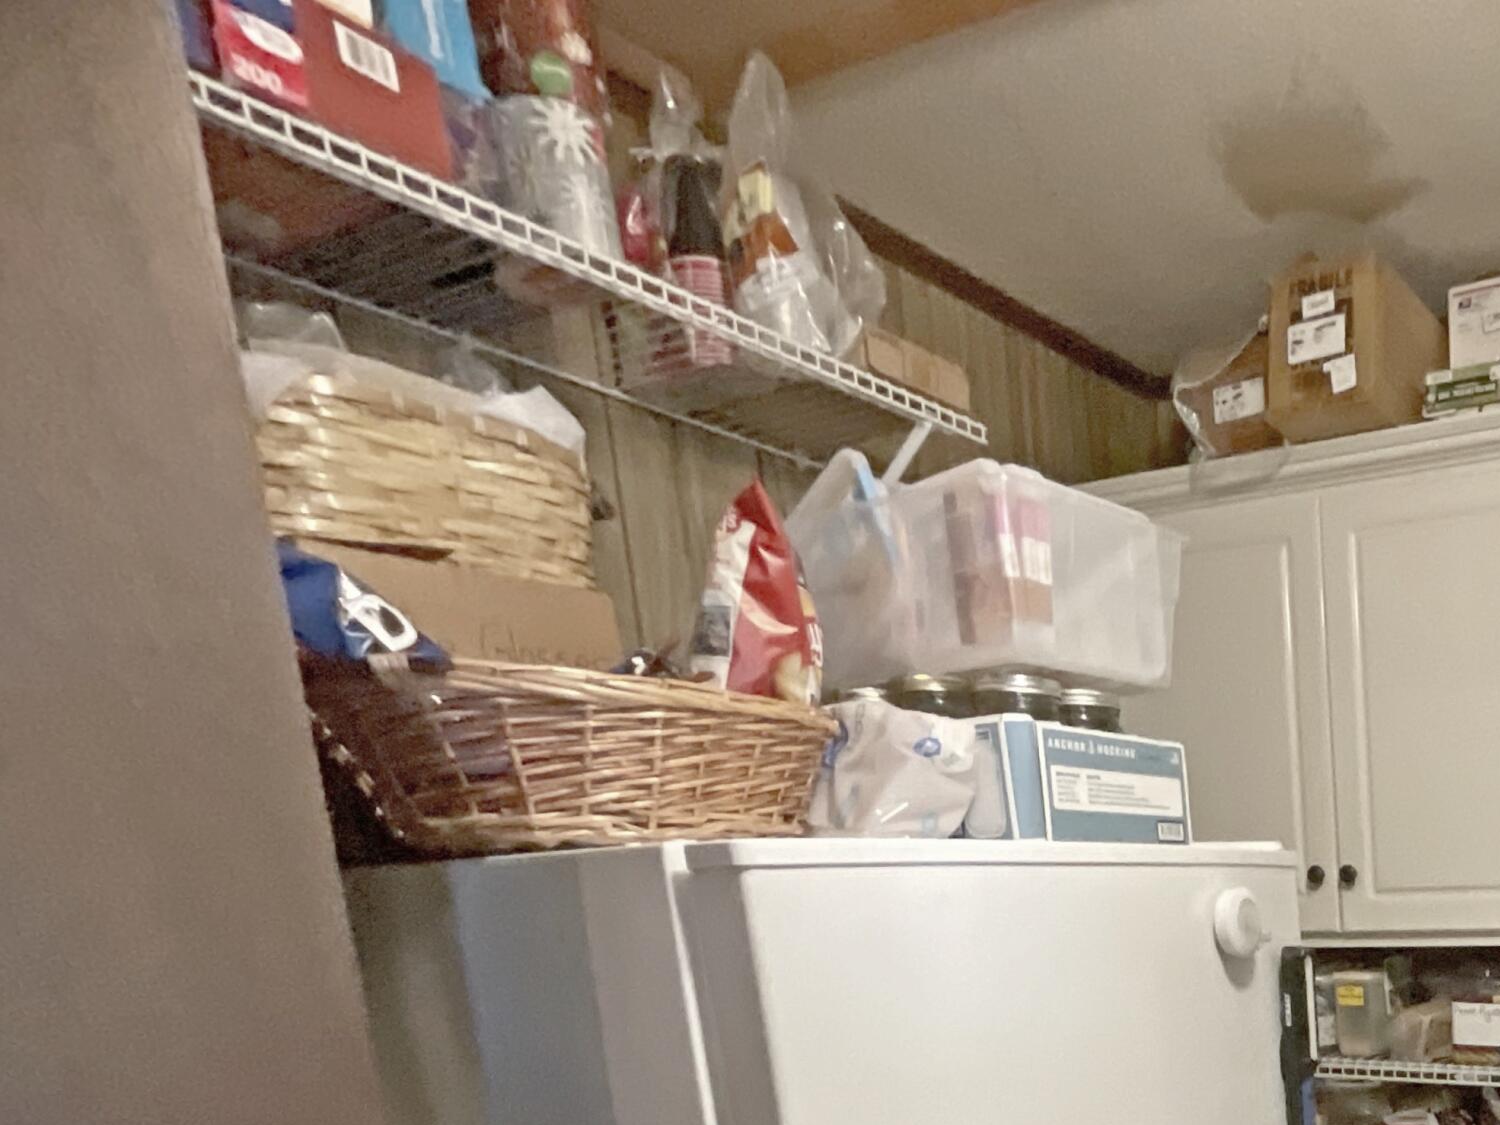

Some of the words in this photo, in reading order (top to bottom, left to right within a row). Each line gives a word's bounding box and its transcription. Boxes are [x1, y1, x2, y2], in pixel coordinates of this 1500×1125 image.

[230, 53, 284, 95] 200
[1048, 736, 1086, 753] ANCHOR
[1097, 743, 1136, 760] HOCKING
